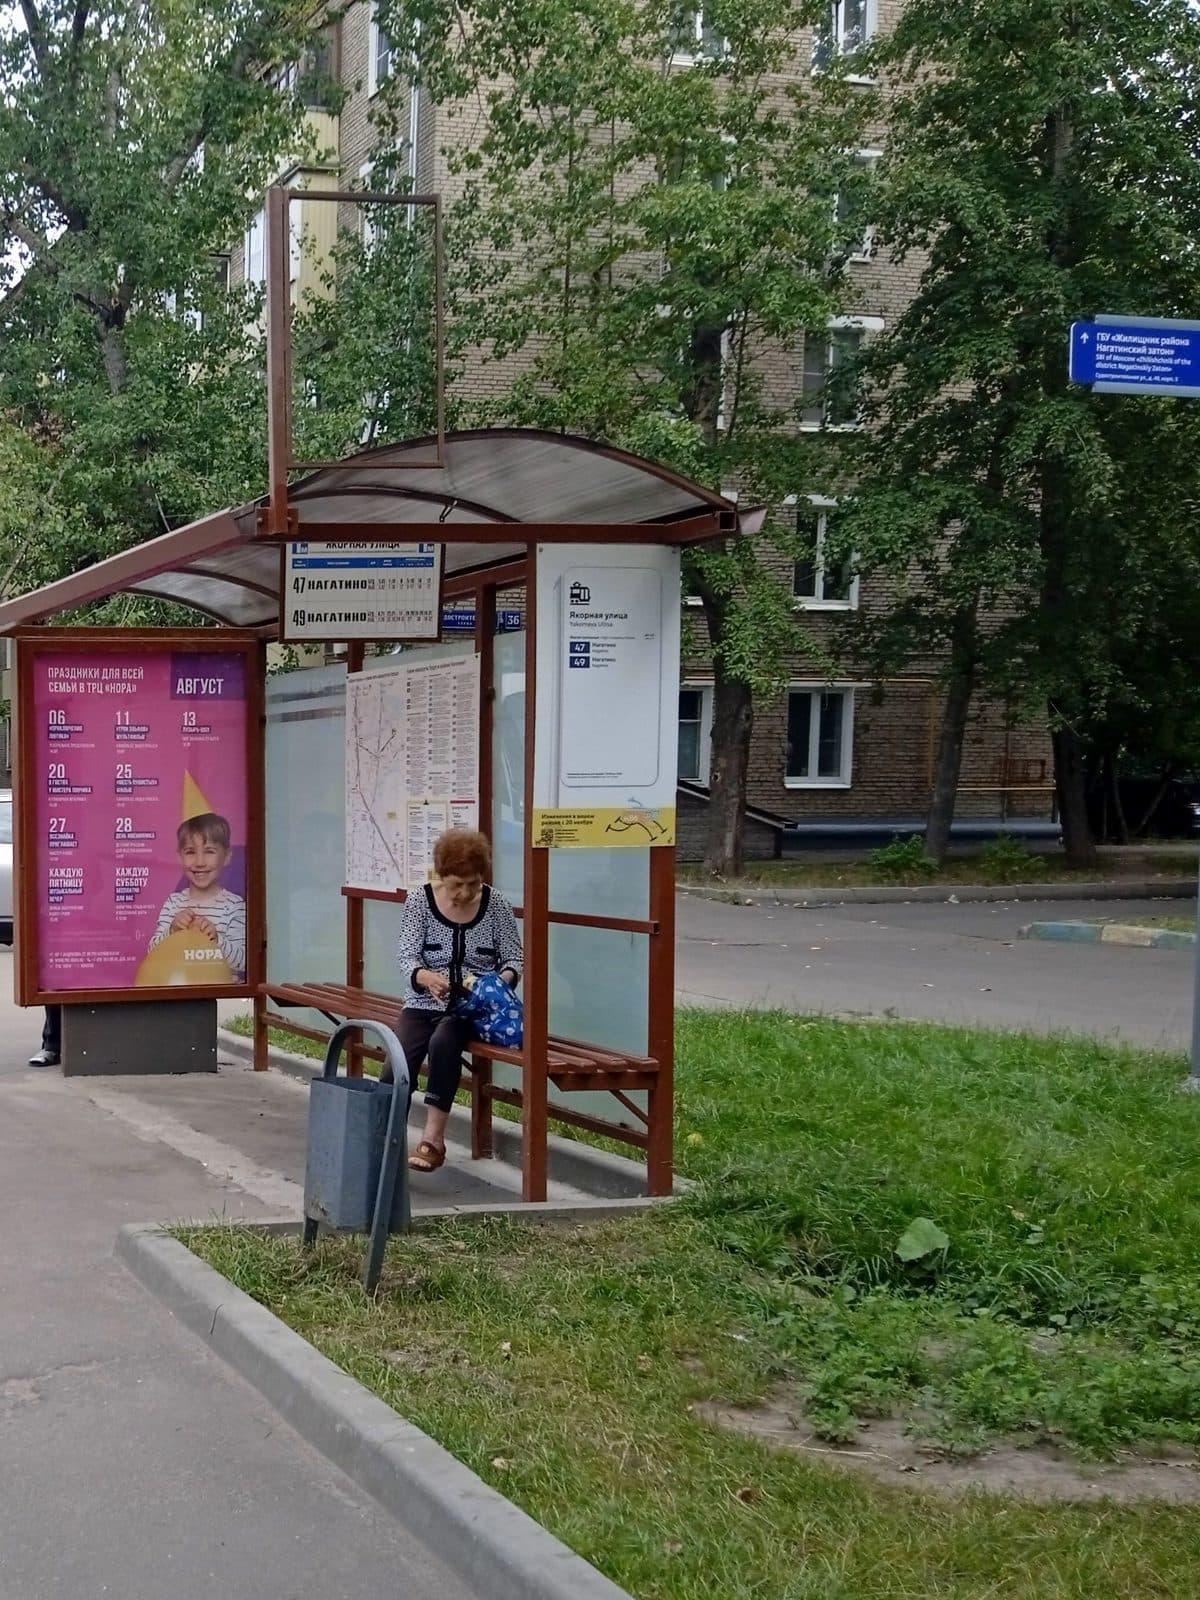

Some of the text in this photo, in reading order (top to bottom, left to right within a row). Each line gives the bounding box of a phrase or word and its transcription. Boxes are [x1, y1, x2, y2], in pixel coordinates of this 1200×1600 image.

[1096, 332, 1190, 346] ГБУ «Жилищник района
[1096, 344, 1175, 356] Нагатинский затон»
[292, 577, 306, 593] 47
[308, 580, 367, 590] НАГАТИНО
[292, 610, 306, 626] 49
[307, 612, 367, 623] НАГАТИНО
[507, 615, 520, 625] 36
[569, 611, 603, 620] Якорная
[574, 643, 586, 652] 47
[574, 658, 586, 666] 49
[47, 666, 144, 680] ПРАЗДНИКИ ДЛЯ ВСЕЙ
[48, 681, 137, 694] СЕМЬИ В ТРЦ «НОРА»
[176, 678, 224, 695] АВГУСТ
[49, 710, 66, 725] 06
[116, 711, 130, 725] 11
[182, 711, 196, 726] 13
[48, 763, 65, 779] 20
[116, 764, 132, 779] 25
[49, 818, 66, 833] 27
[116, 817, 132, 833] 28
[49, 868, 83, 878] КАЖДУЮ
[116, 867, 149, 877] КАЖДУЮ
[49, 878, 83, 888] ПЯТНИЦУ
[116, 877, 148, 888] СУББОТУ
[183, 949, 223, 961] НОРА
